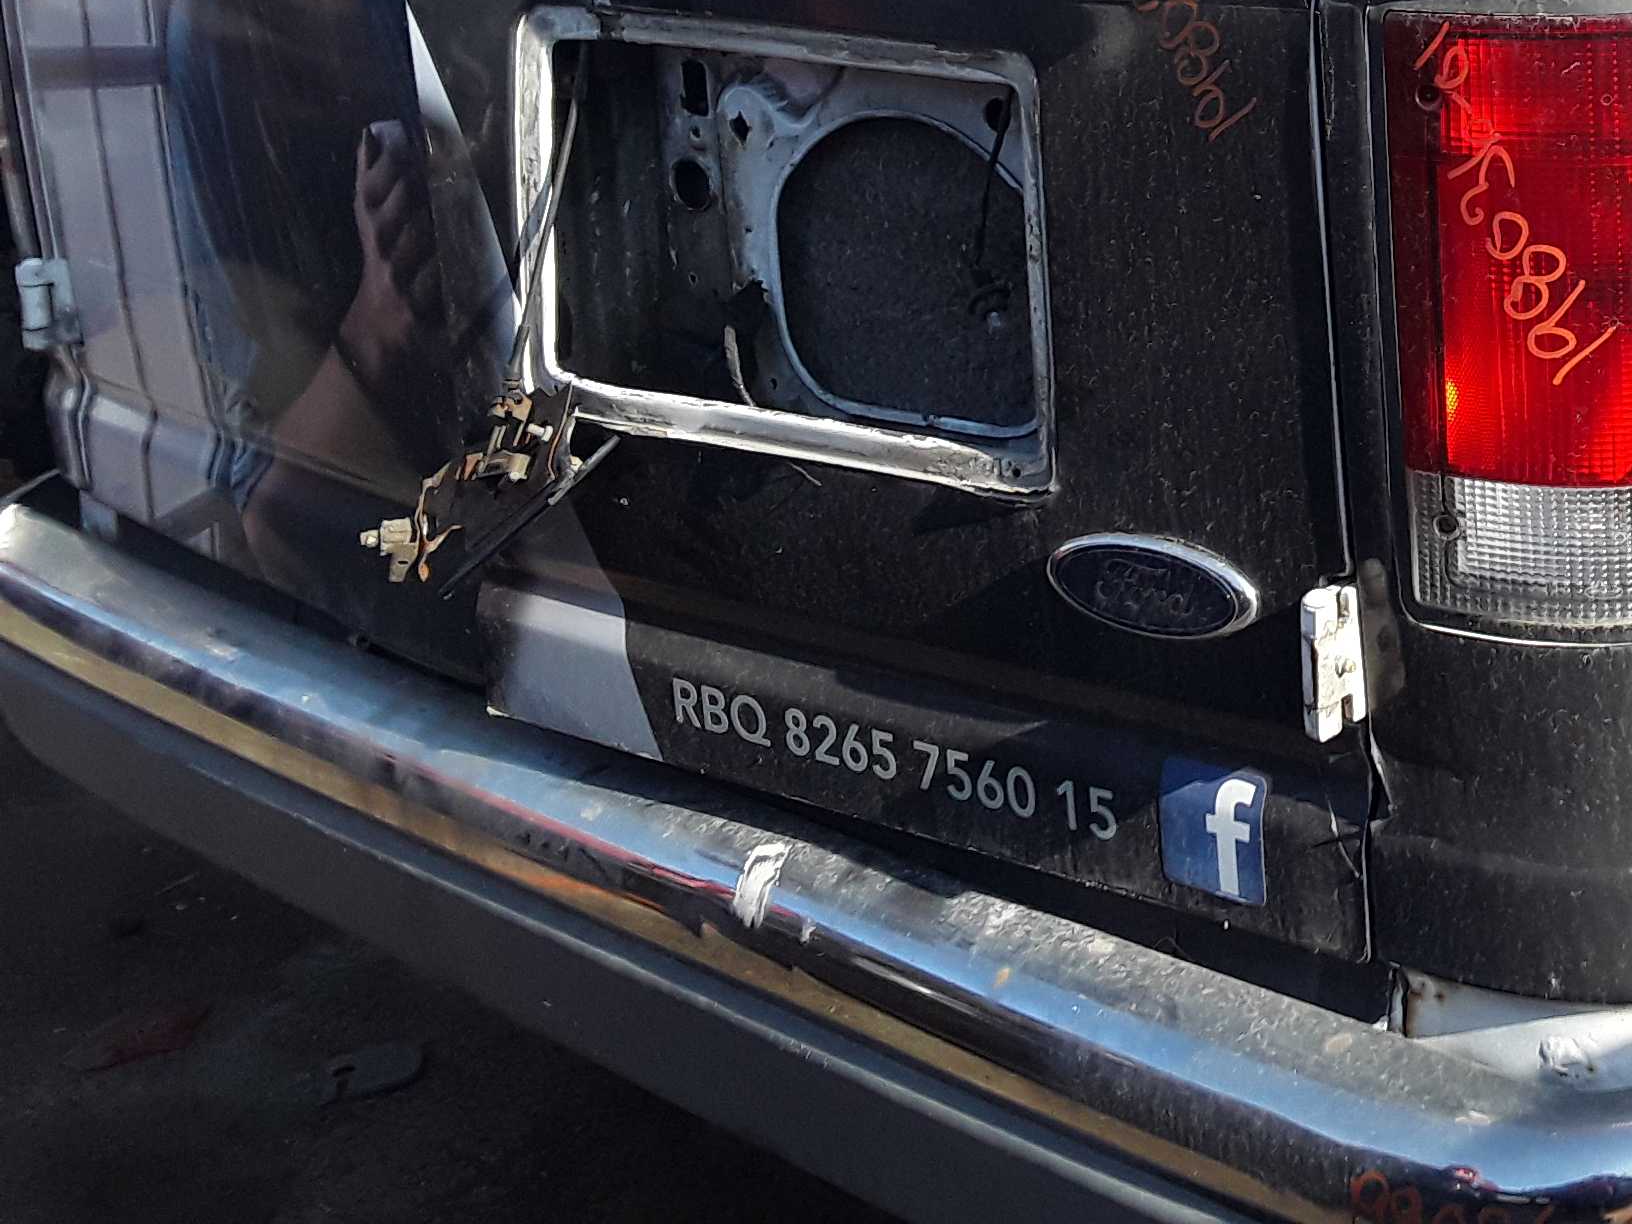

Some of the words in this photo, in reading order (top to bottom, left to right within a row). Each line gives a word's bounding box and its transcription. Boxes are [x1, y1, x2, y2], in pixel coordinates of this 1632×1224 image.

[672, 676, 772, 750] RBQ
[783, 706, 898, 782] 8265
[911, 738, 1037, 820] 7560
[1056, 777, 1119, 842] 15
